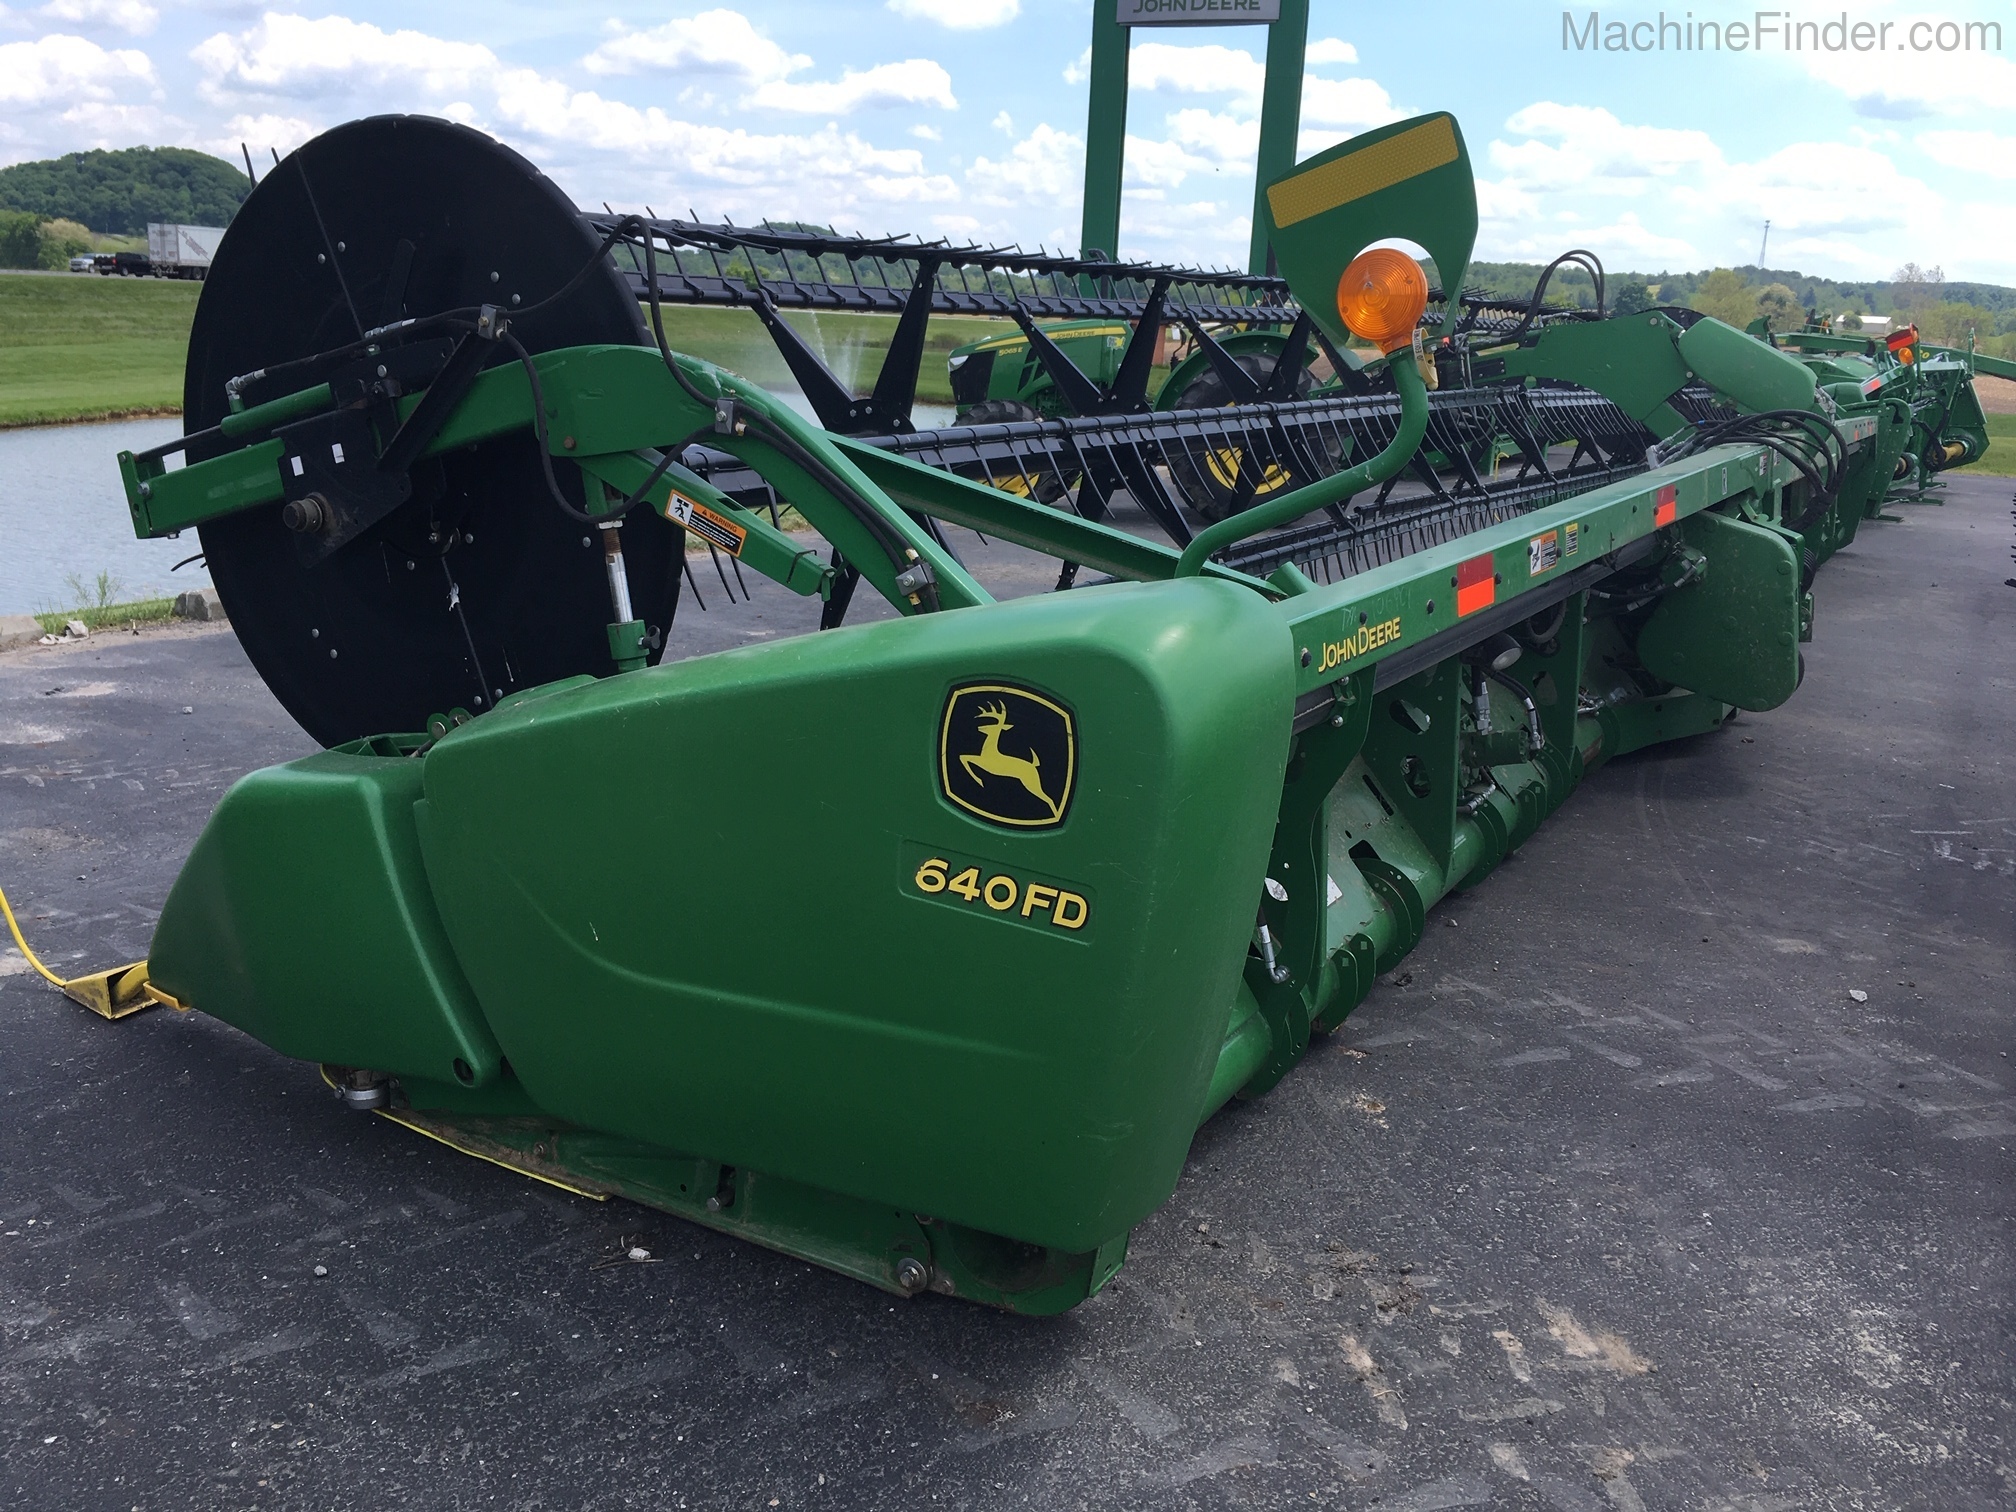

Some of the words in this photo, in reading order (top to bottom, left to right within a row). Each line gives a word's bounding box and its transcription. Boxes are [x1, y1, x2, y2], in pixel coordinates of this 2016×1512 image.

[709, 512, 738, 533] WARNING
[1317, 634, 1357, 673] JOHN
[1358, 616, 1401, 655] DEERE
[914, 857, 1089, 930] 640FD
